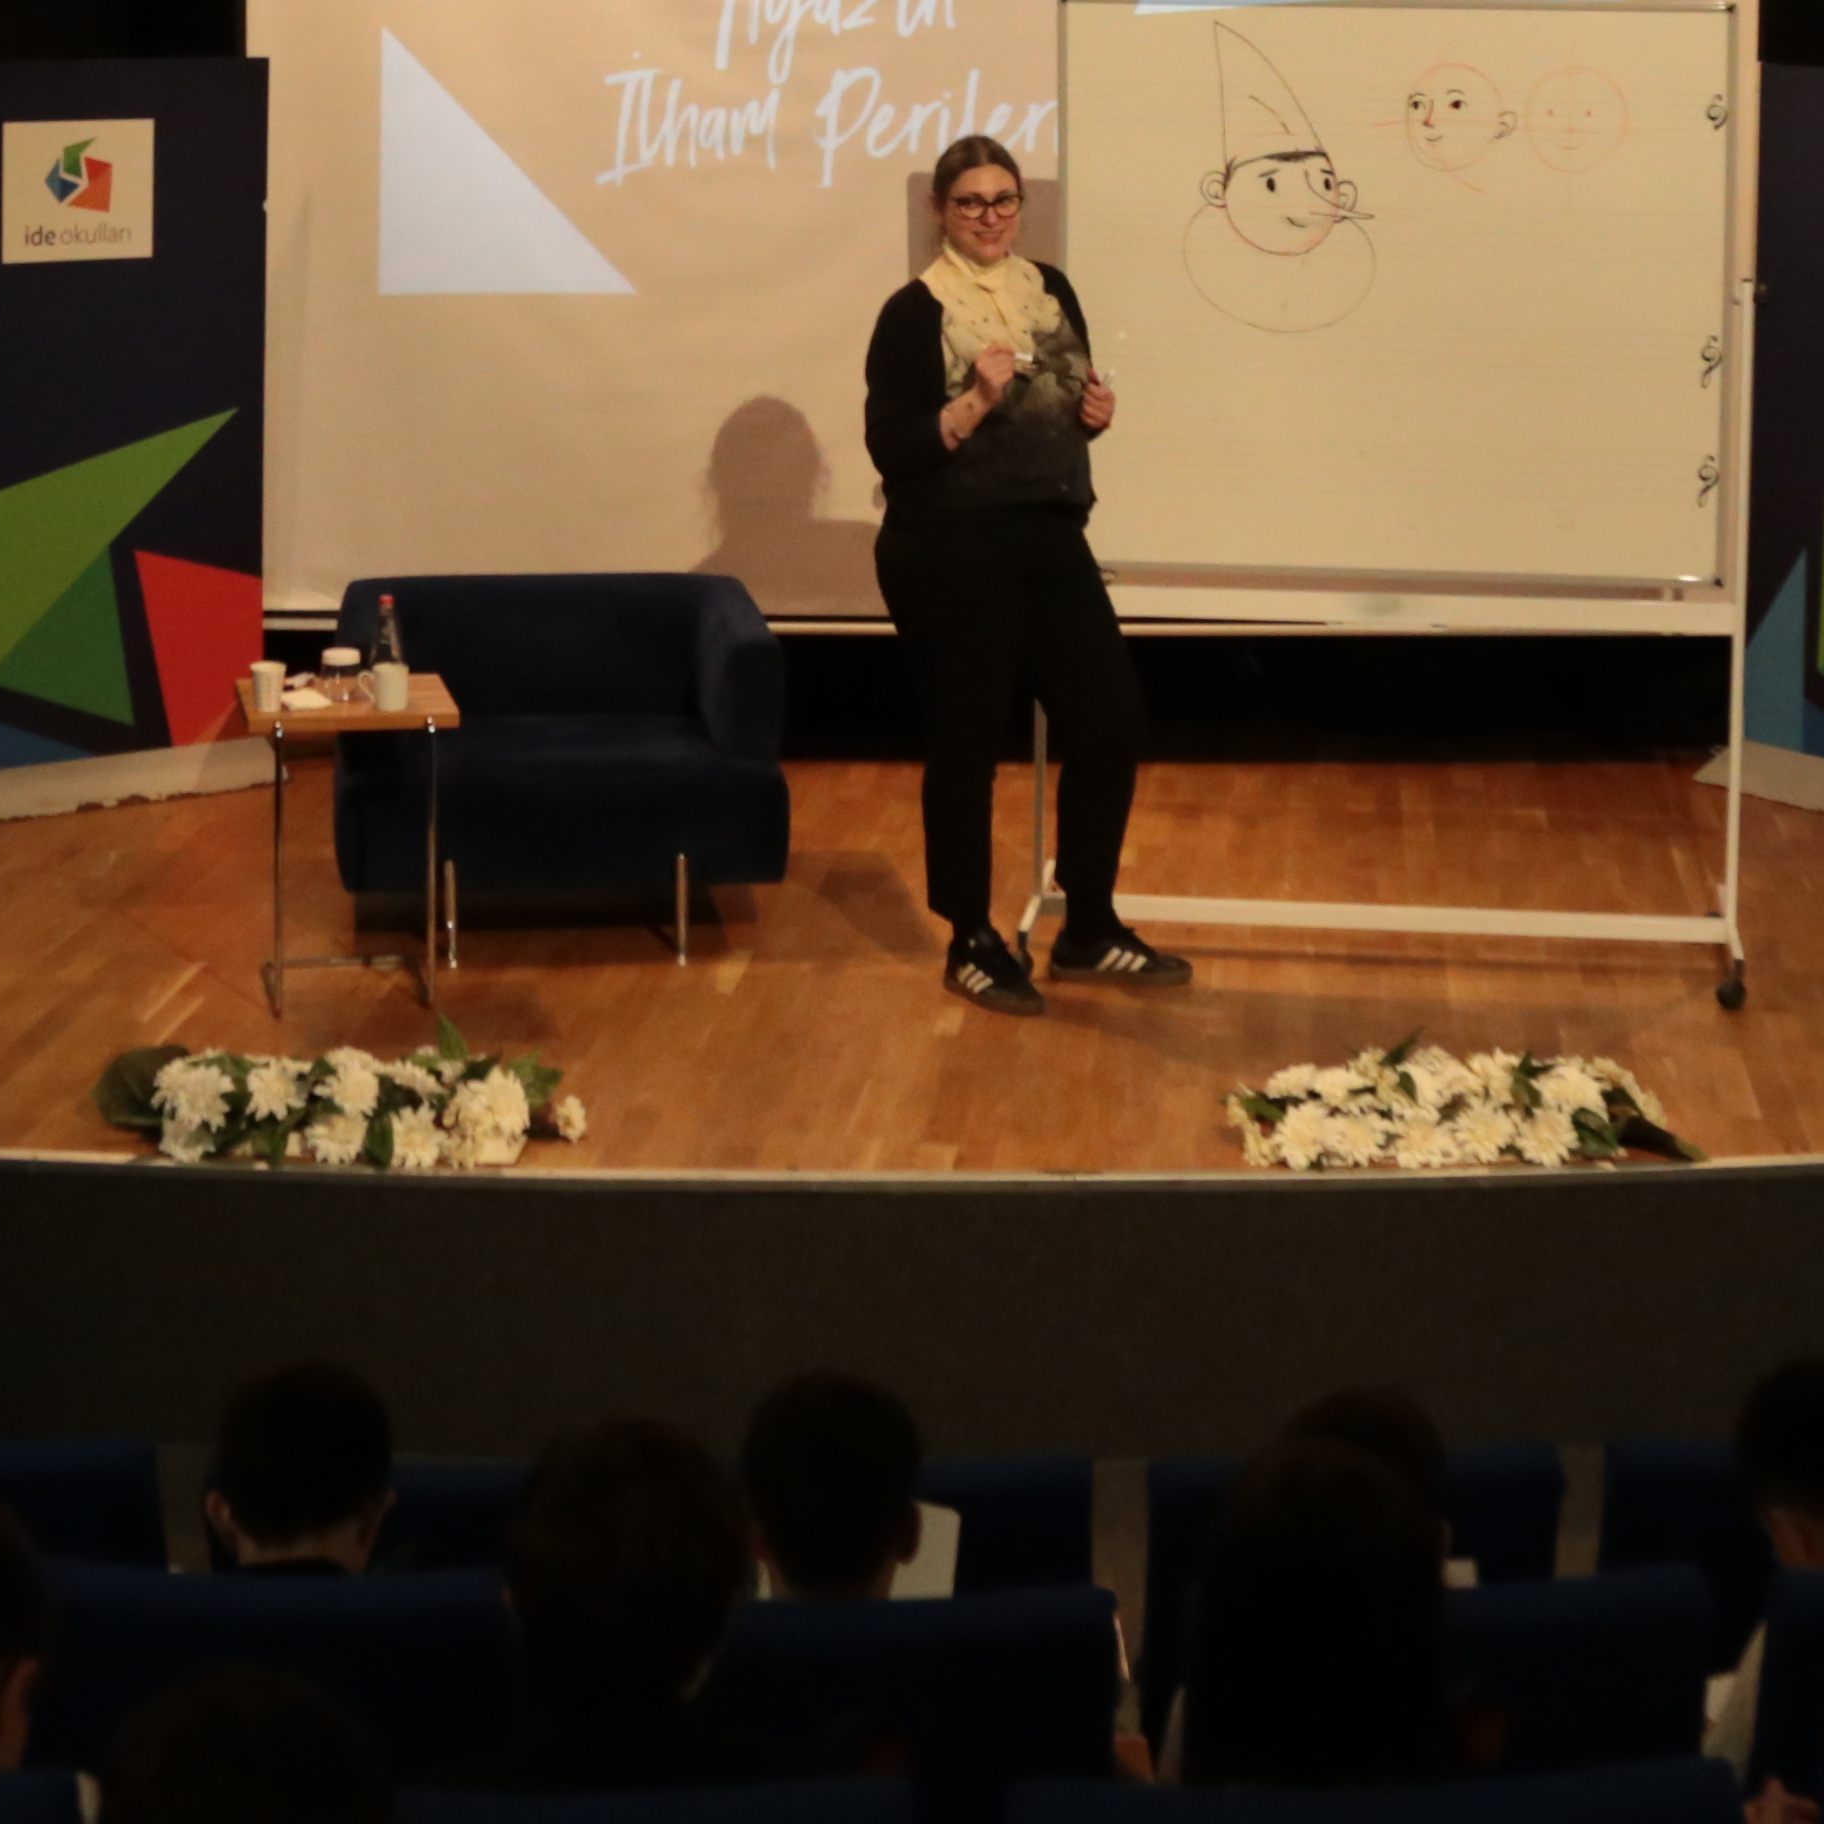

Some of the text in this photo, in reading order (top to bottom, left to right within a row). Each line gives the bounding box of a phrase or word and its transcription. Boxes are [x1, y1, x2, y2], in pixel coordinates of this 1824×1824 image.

[594, 51, 1058, 189] İlham Periler
[24, 224, 56, 247] ide
